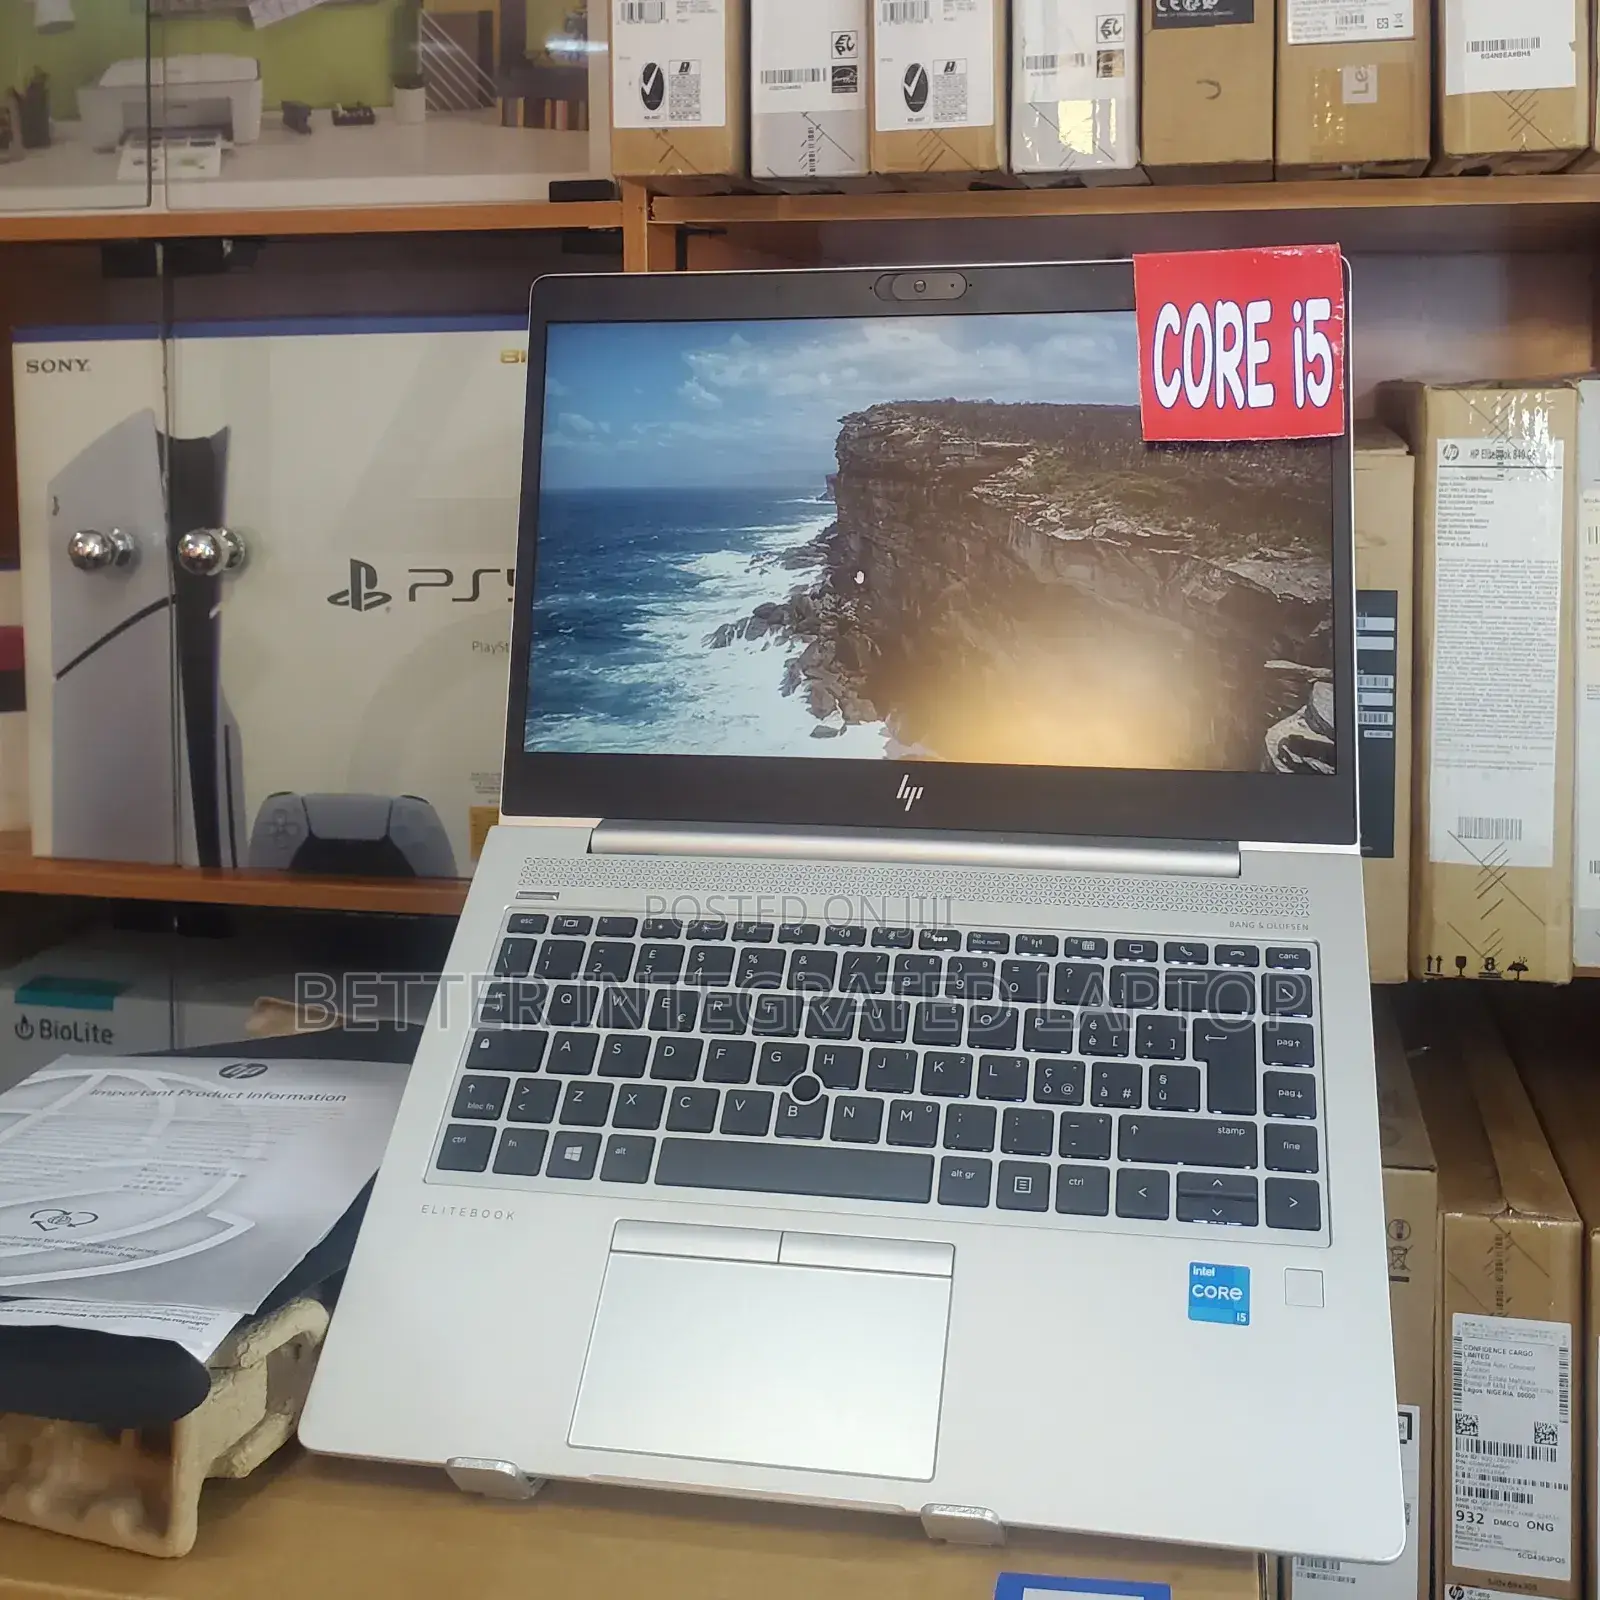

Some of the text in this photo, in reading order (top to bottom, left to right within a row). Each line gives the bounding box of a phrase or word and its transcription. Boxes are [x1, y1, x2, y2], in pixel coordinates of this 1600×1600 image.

[1153, 297, 1334, 409] CORE i5
[26, 358, 88, 374] SONY
[408, 569, 515, 602] PS
[1229, 921, 1255, 929] BANG
[593, 963, 602, 972] 2
[560, 993, 572, 1005] Q
[612, 995, 627, 1007] W
[661, 998, 671, 1009] E
[713, 1001, 724, 1011] R
[872, 1008, 882, 1019] U
[1034, 1018, 1044, 1028] P
[39, 1018, 114, 1045] BioLite
[560, 1041, 572, 1052] A
[612, 1043, 622, 1054] S
[663, 1046, 675, 1057] D
[716, 1048, 726, 1059] F
[770, 1051, 783, 1063] G
[823, 1053, 835, 1065] H
[878, 1058, 886, 1069] J
[934, 1061, 945, 1072] K
[989, 1065, 998, 1076] L
[90, 1088, 347, 1102] Important Product Information
[467, 1102, 494, 1111] bloc fn
[573, 1090, 584, 1102] Z
[626, 1094, 638, 1105] X
[680, 1097, 691, 1108] C
[735, 1100, 746, 1111] V
[788, 1106, 799, 1117] B
[844, 1107, 854, 1118] N
[901, 1110, 913, 1122] M
[1217, 1127, 1245, 1137] stamp
[1283, 1141, 1301, 1150] fine
[452, 1136, 1084, 1187] ctrl fn alt alt gr ctrl
[421, 1204, 515, 1221] ELITEBOOK
[1192, 1265, 1216, 1277] intel
[1463, 1344, 1534, 1357] CONFIDENCE CARGO
[1463, 1351, 1490, 1360] LIMITED
[1486, 1389, 1514, 1397] NIGERIA
[1456, 1510, 1485, 1525] 932
[1526, 1520, 1554, 1532] ONG
